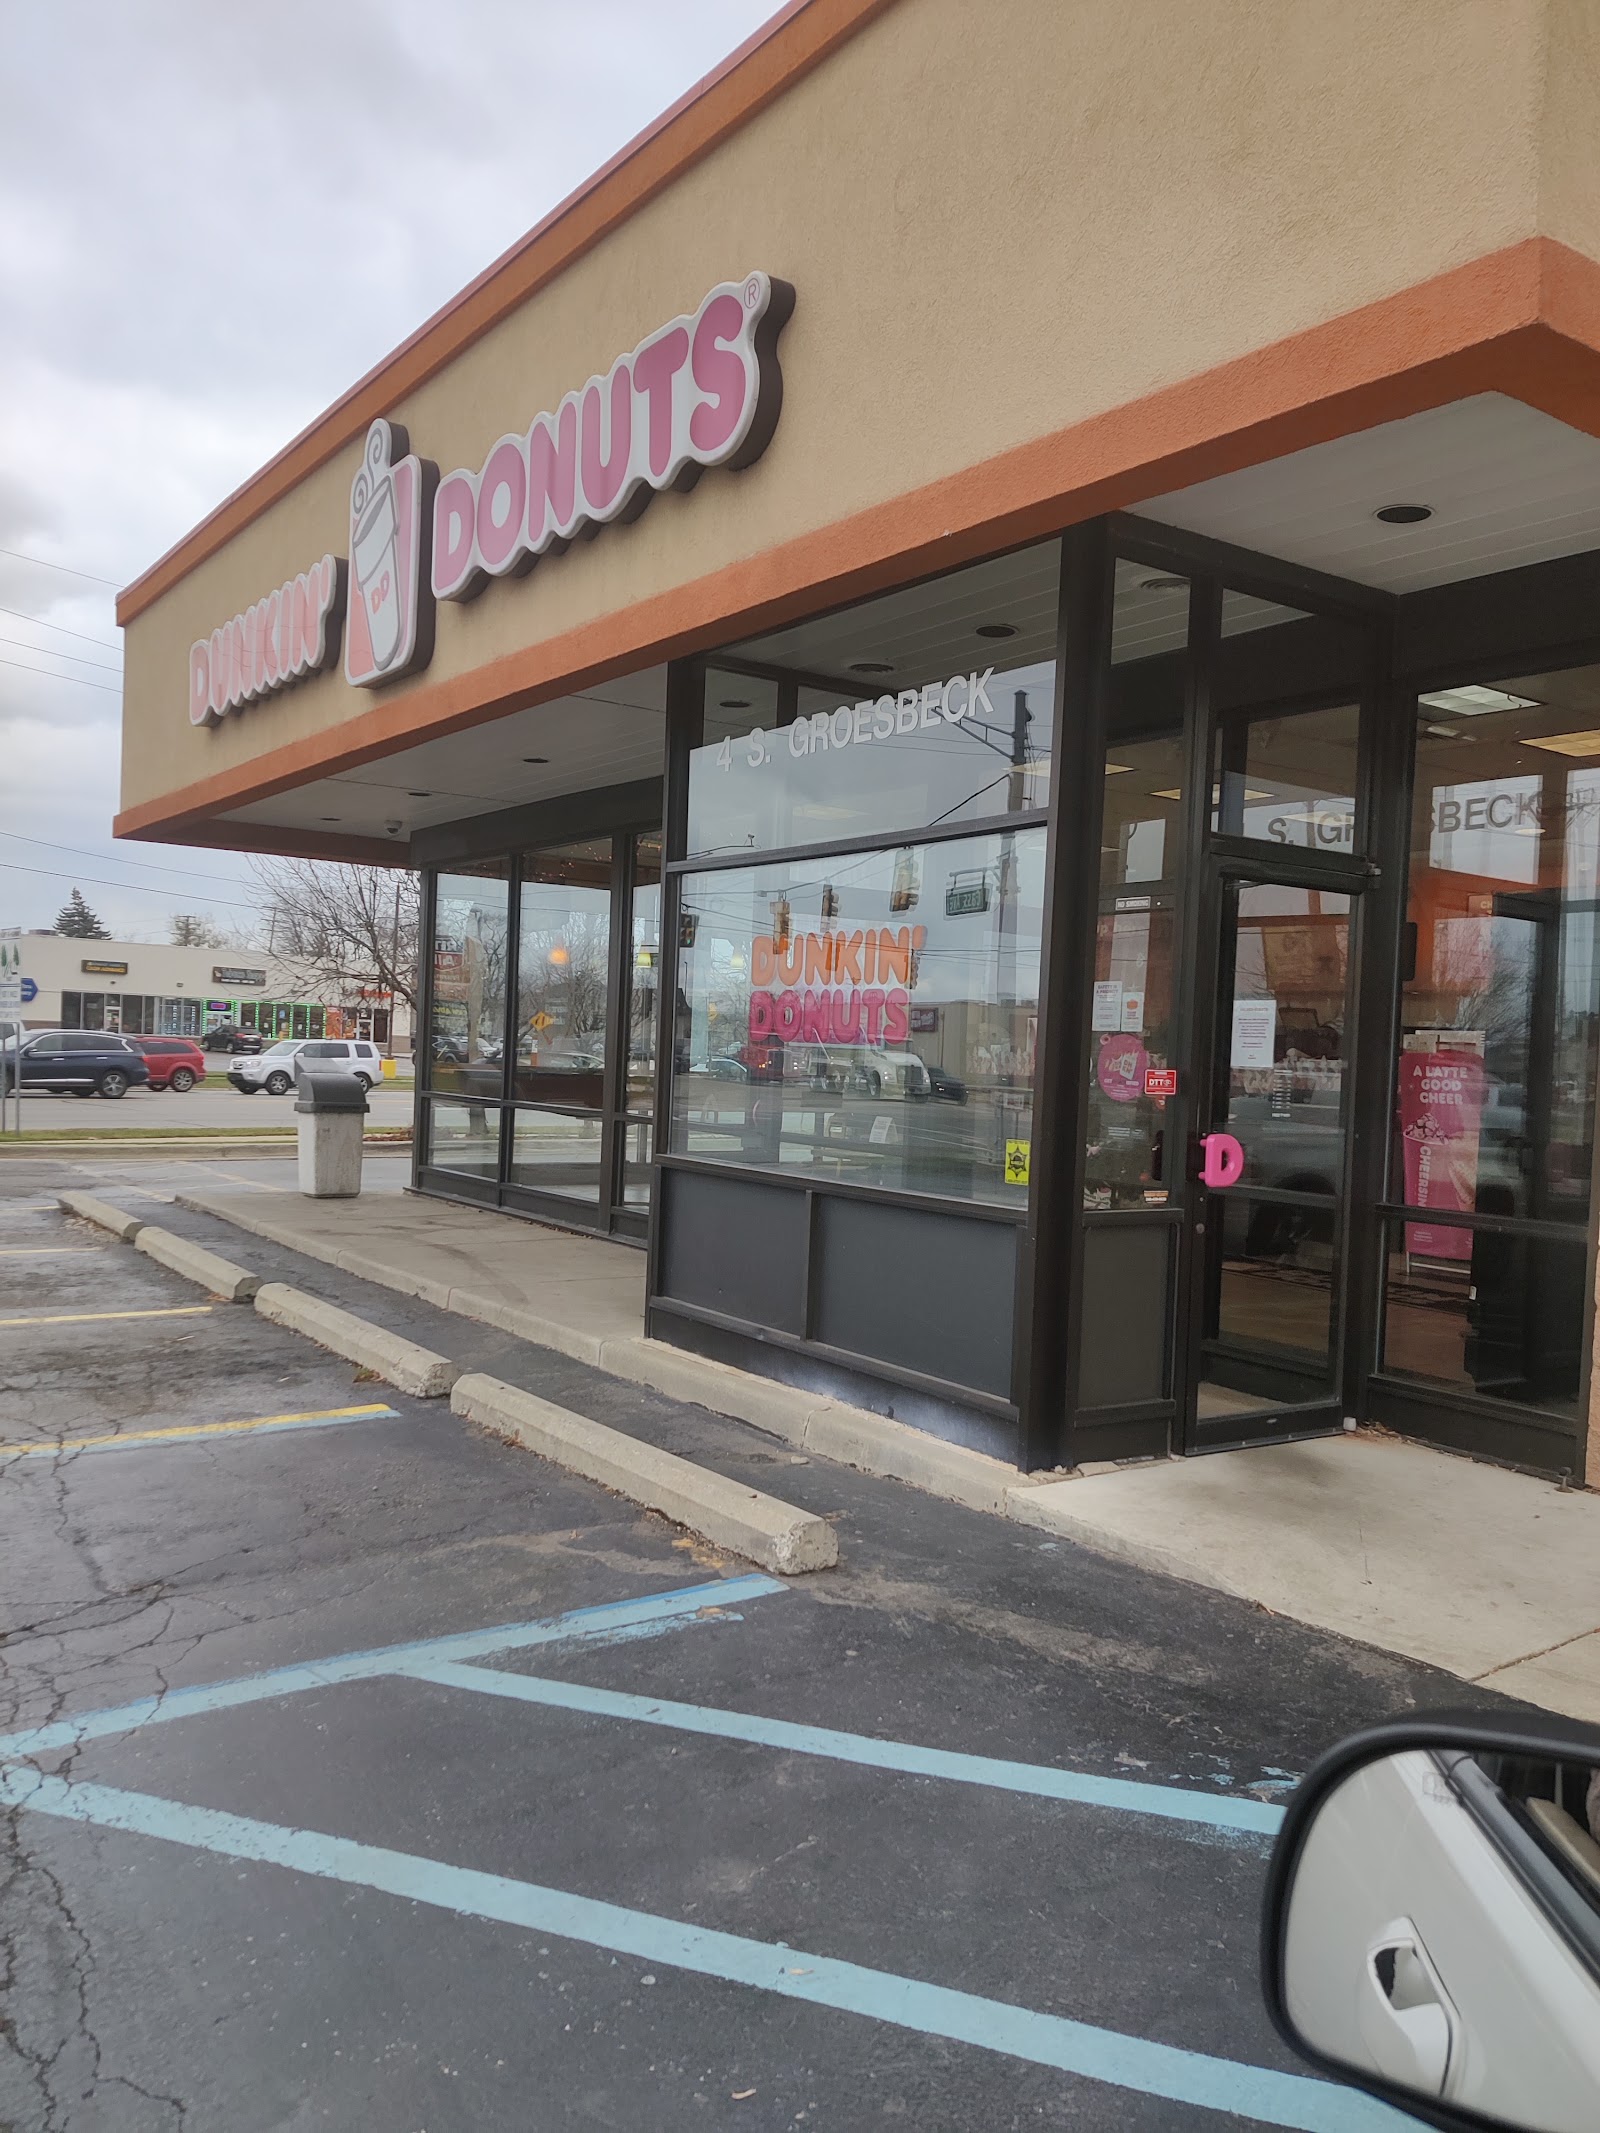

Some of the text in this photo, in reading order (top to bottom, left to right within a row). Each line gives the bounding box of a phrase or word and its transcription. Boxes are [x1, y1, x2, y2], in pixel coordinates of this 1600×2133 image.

[435, 293, 746, 592] DONUTS
[190, 559, 330, 722] DUNKIN'
[716, 666, 996, 772] 4 S. GROESBECK
[752, 925, 928, 987] DUNKIN'
[749, 987, 908, 1046] DONUTS
[1412, 1064, 1468, 1079] A LATTE
[1419, 1091, 1464, 1105] CHEER
[1421, 1078, 1462, 1092] GOOD
